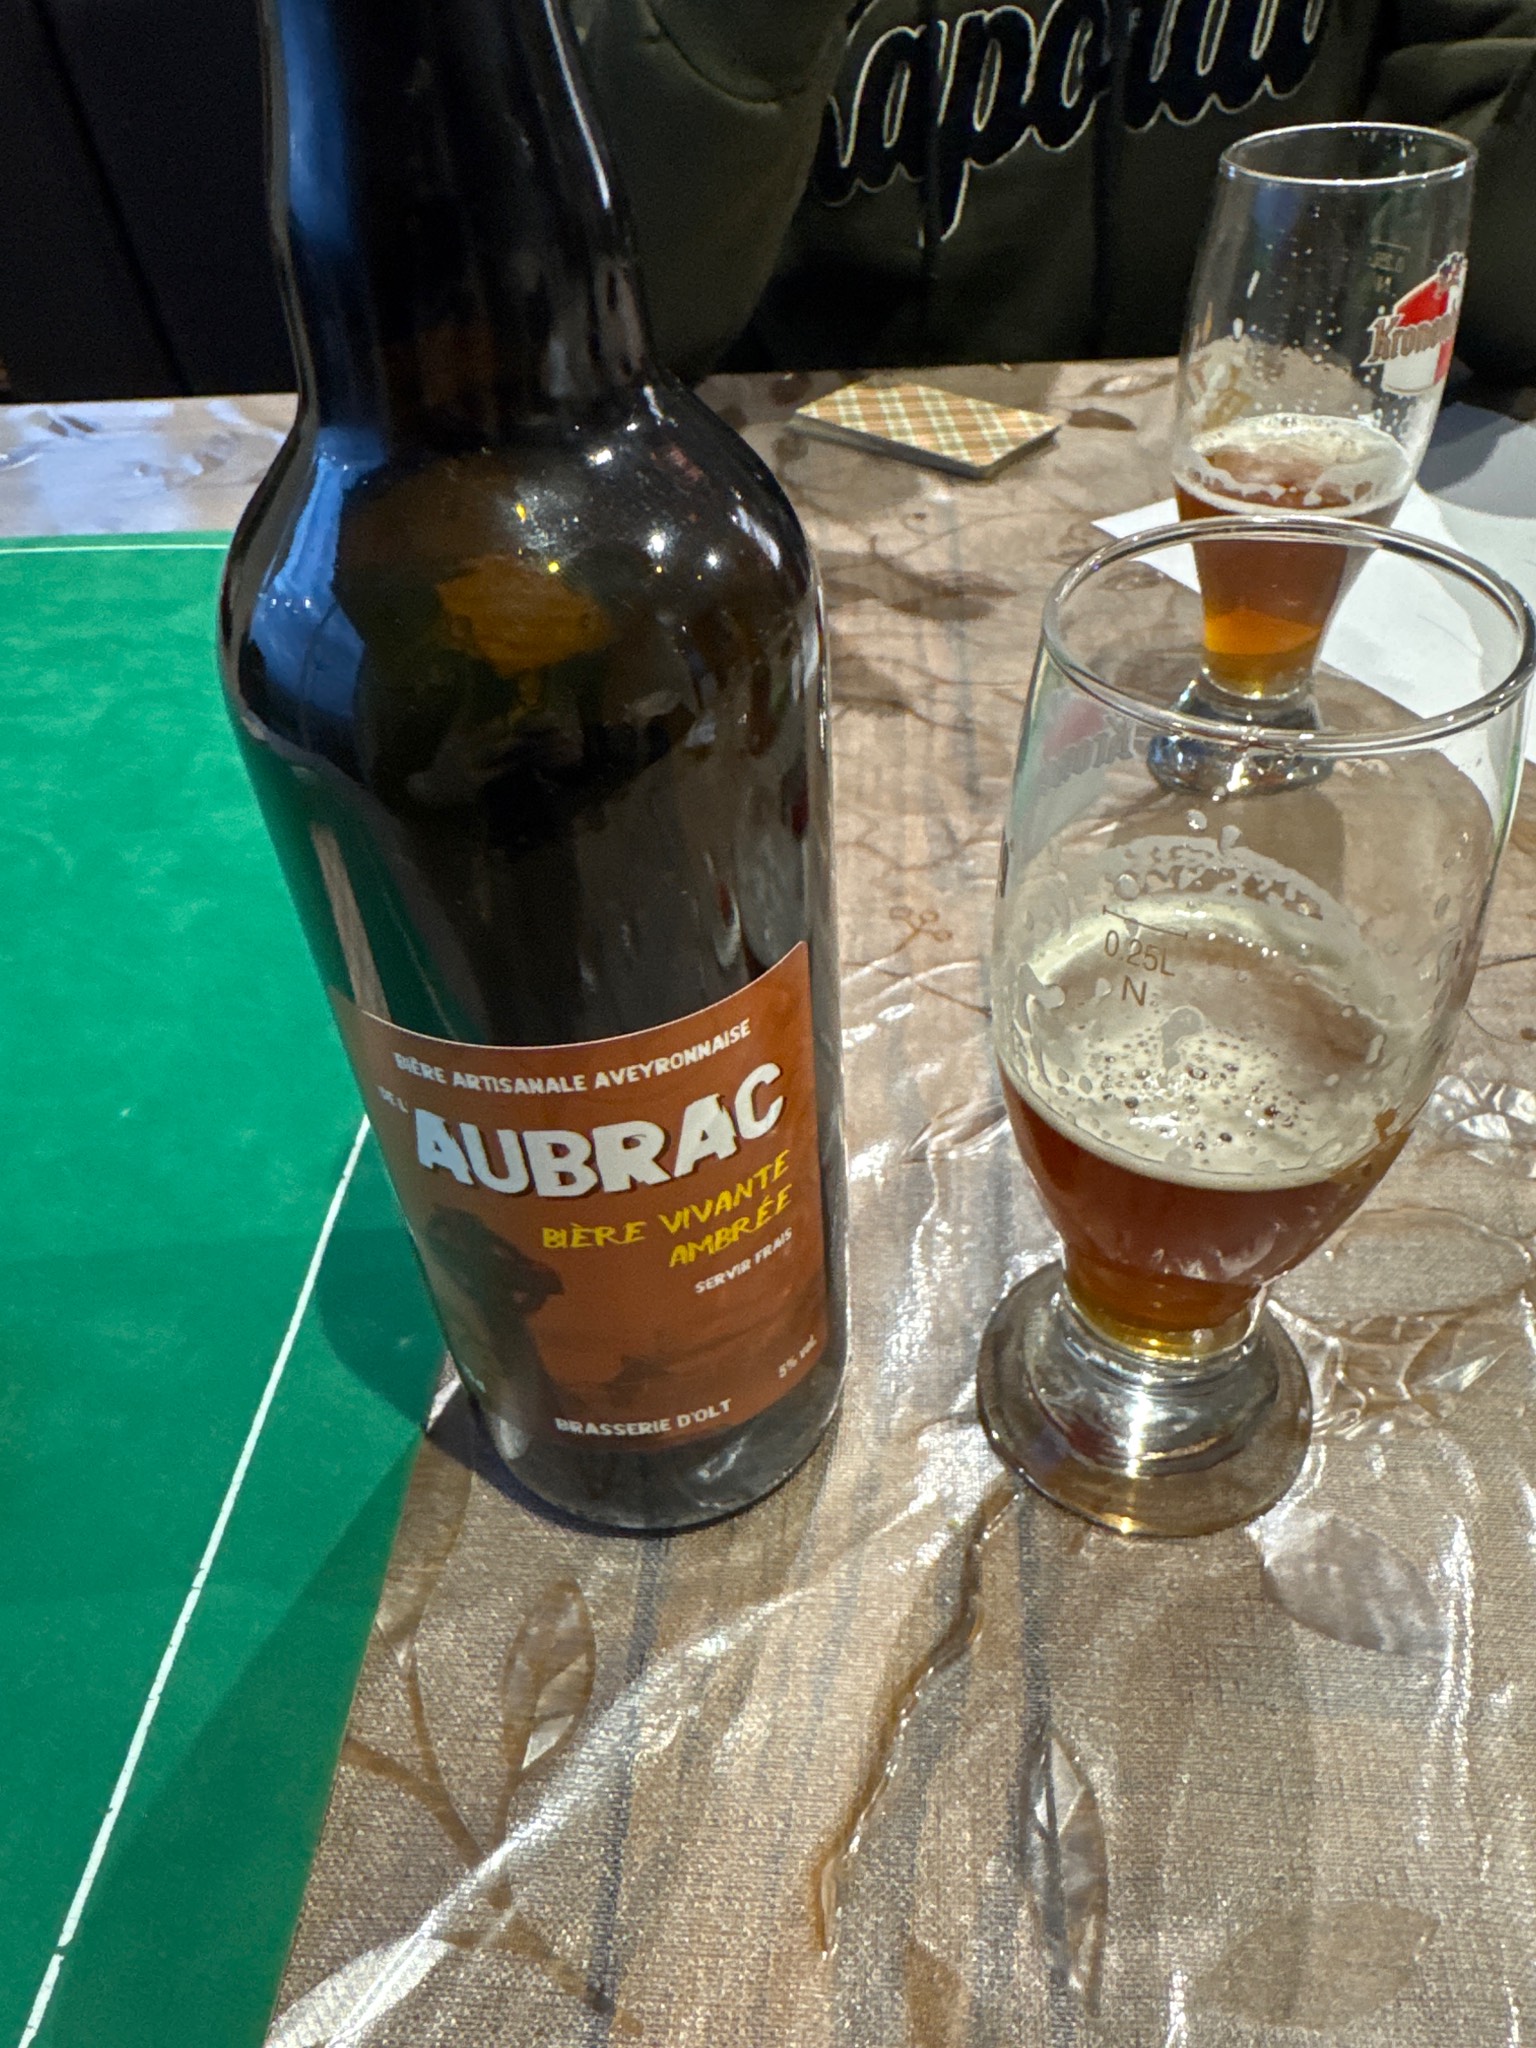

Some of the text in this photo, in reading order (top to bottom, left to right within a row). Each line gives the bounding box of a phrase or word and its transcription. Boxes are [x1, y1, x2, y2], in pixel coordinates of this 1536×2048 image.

[1104, 929, 1175, 977] 0.25L
[1121, 974, 1147, 1007] N
[452, 1070, 588, 1095] ARTISANALE
[594, 1017, 752, 1090] AVEYRONNAISE
[414, 1062, 787, 1198] AUBRAC
[541, 1148, 790, 1249] BIÈRE VIVANTE
[668, 1183, 793, 1268] AMBRÉE
[694, 1226, 793, 1294] SERVIR FRAIS
[554, 1397, 733, 1437] BRASSERIE D'OLT
